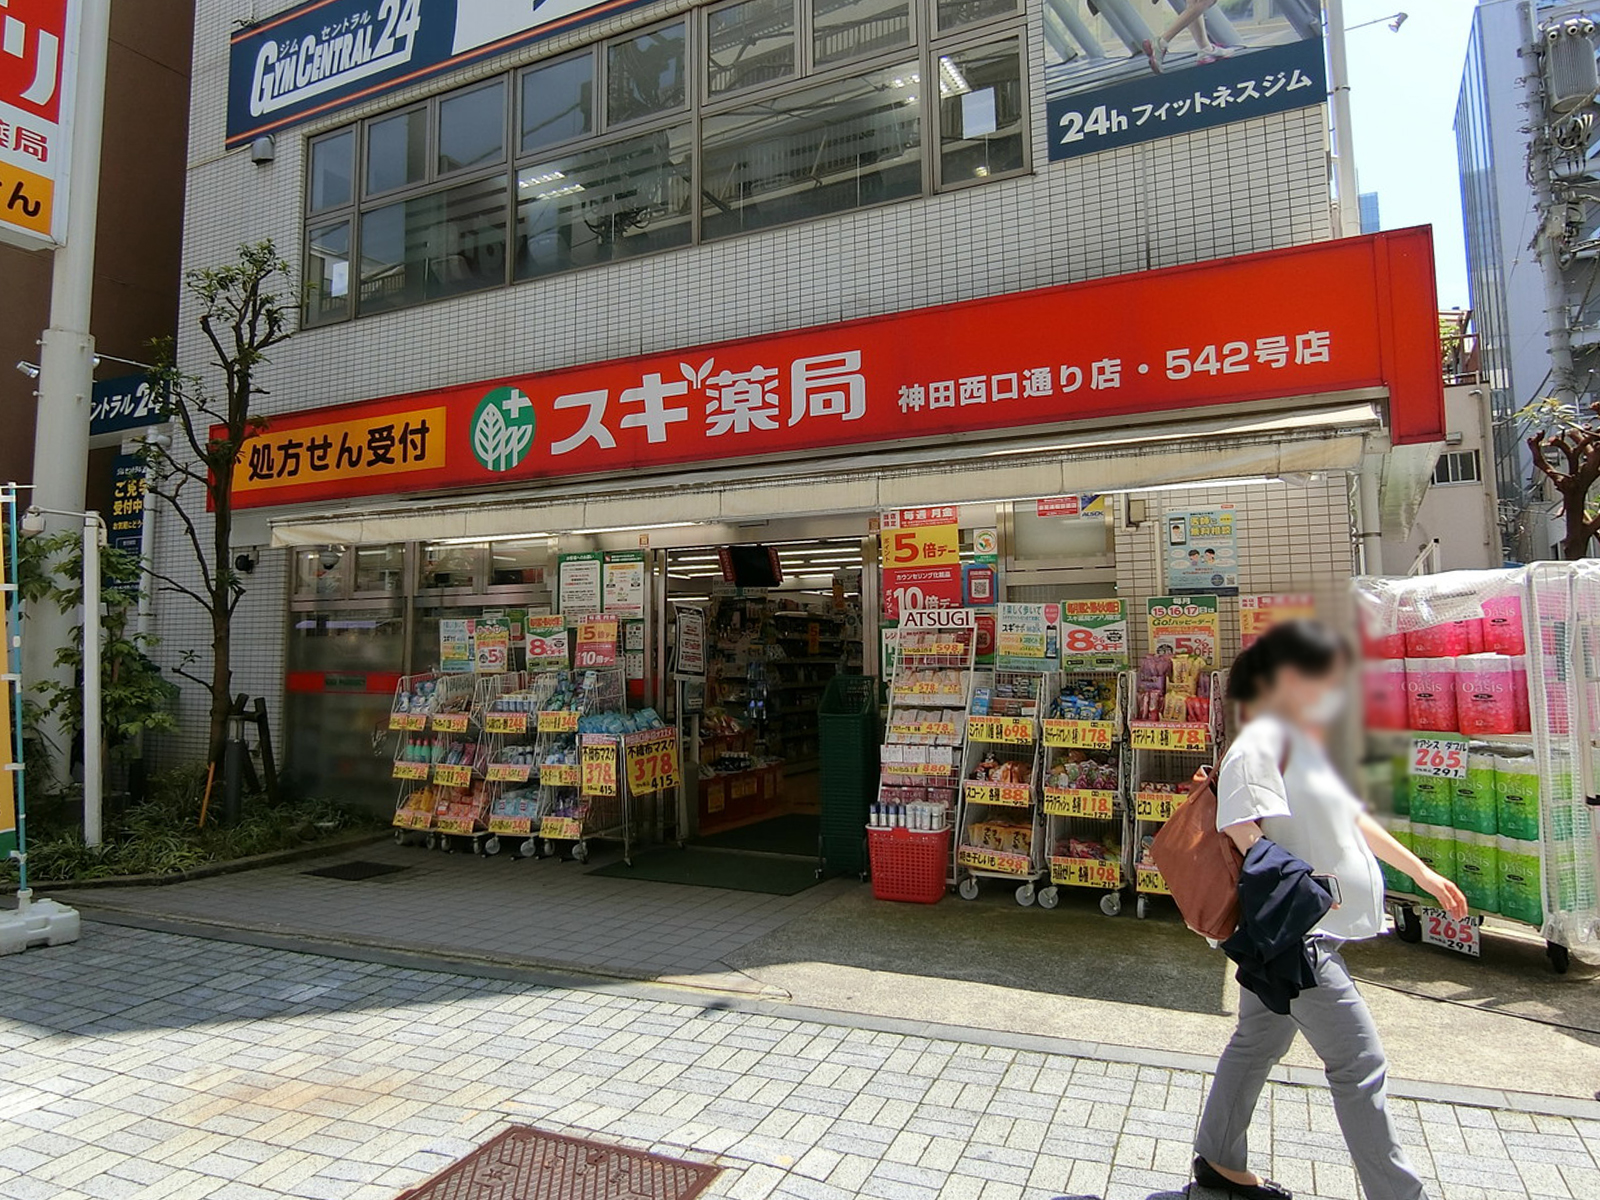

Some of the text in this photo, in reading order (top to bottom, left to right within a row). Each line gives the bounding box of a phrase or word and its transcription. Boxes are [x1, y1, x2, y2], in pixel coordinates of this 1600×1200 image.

[279, 10, 371, 58] ジム セントラル
[249, 0, 421, 118] GYM CENTRAL 24
[247, 419, 431, 482] 処方せん受付
[1152, 607, 1165, 616] 15
[1168, 607, 1181, 615] 16
[1185, 606, 1198, 615] 17
[1484, 607, 1516, 617] Oasis
[904, 611, 970, 627] ATSUGI
[936, 644, 959, 652] 598
[1408, 681, 1442, 692] Oasis
[1462, 681, 1504, 693] Oasis
[926, 723, 949, 731] 478
[1004, 724, 1028, 738] 698
[1081, 727, 1107, 742] 178
[1172, 729, 1200, 743] 78
[627, 739, 675, 759] 不織布マスク
[1413, 739, 1440, 750] オアシス
[1415, 748, 1461, 769] 265
[586, 762, 613, 784] 378
[634, 752, 673, 781] 378
[922, 764, 946, 772] 880
[1432, 767, 1459, 777] 291
[651, 774, 673, 788] 415
[600, 785, 613, 795] 415
[966, 786, 986, 799] スコーン
[1001, 788, 1024, 801] 88
[1498, 783, 1533, 796] Oasis
[1082, 796, 1107, 812] 118
[1413, 844, 1441, 859] Oasis
[997, 857, 1022, 871] 298
[1456, 851, 1490, 867] Oasis
[1089, 866, 1115, 881] 198
[1499, 861, 1533, 876] Oasis
[1428, 916, 1473, 943] 265
[1447, 939, 1472, 953] 291
